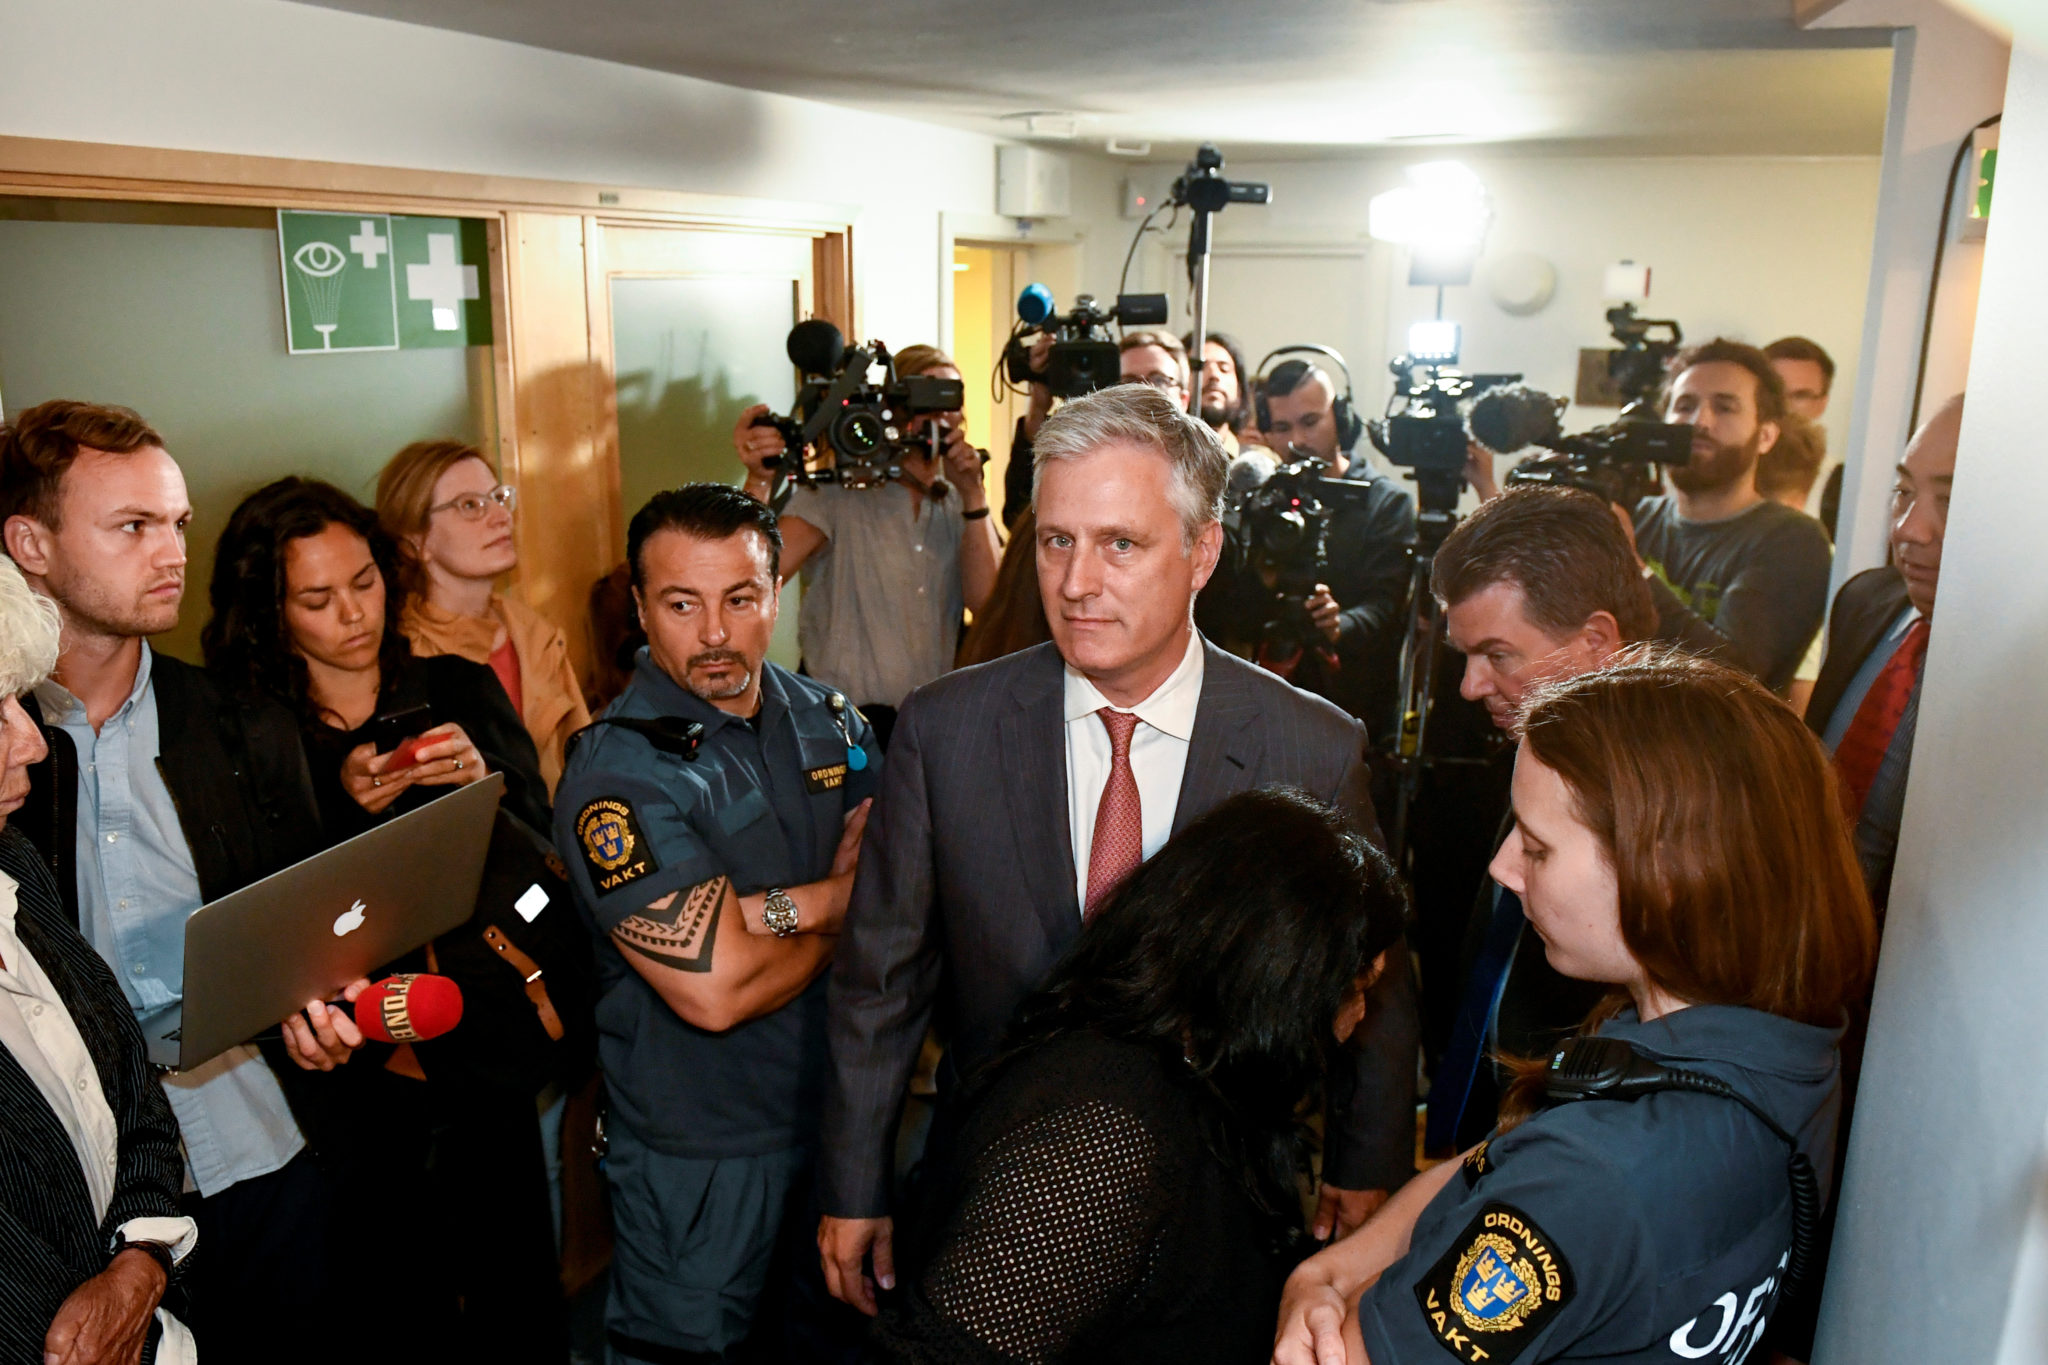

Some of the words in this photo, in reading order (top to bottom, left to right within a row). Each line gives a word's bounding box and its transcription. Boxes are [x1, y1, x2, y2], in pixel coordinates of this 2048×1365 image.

[577, 800, 630, 836] ORDNINGS
[600, 861, 646, 890] VAKT
[1484, 1212, 1562, 1302] ORDNINGS
[1426, 1287, 1490, 1363] VAKT
